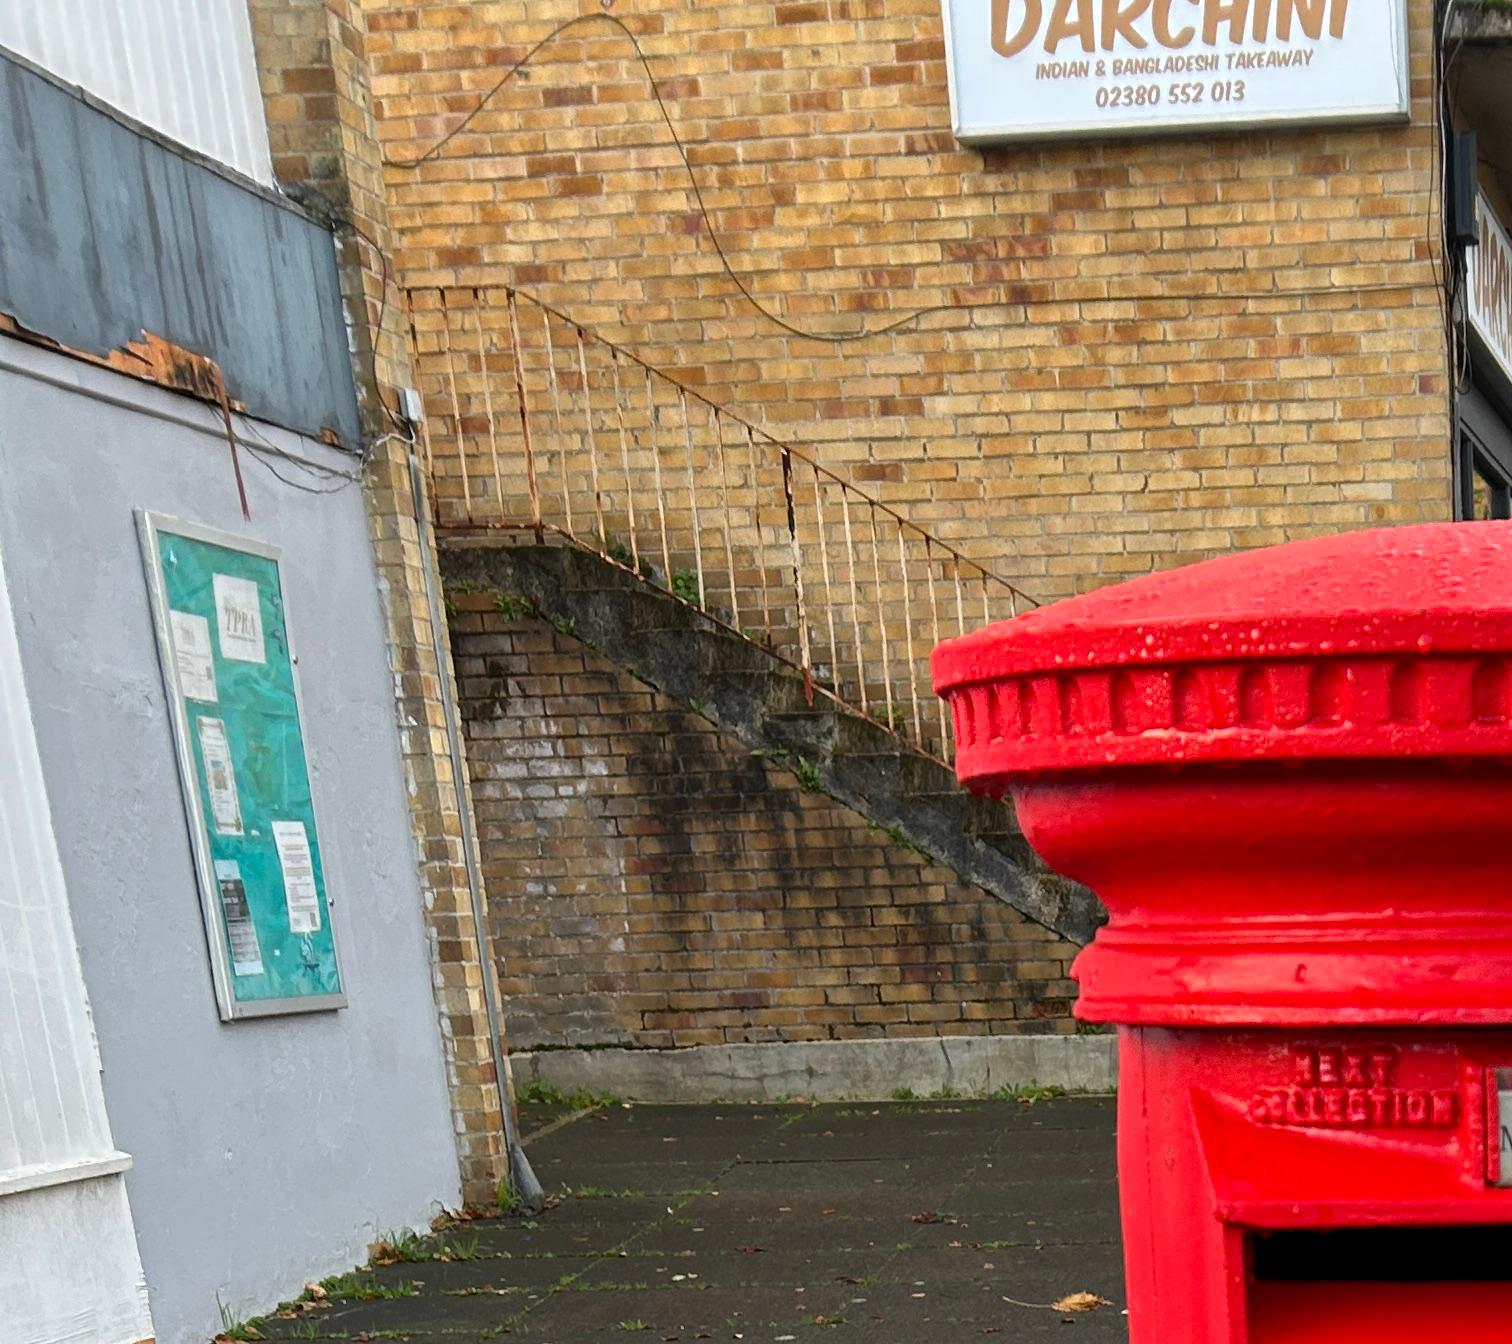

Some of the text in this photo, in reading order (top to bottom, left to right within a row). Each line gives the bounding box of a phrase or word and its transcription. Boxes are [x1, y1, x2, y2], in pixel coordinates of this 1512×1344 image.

[989, 0, 1351, 58] DARCHINI
[1035, 48, 1315, 80] INDIAN & BANGLADESHI TAKEAWAY
[1095, 79, 1246, 108] 02380 552 013
[1248, 1087, 1460, 1127] COLLECTION
